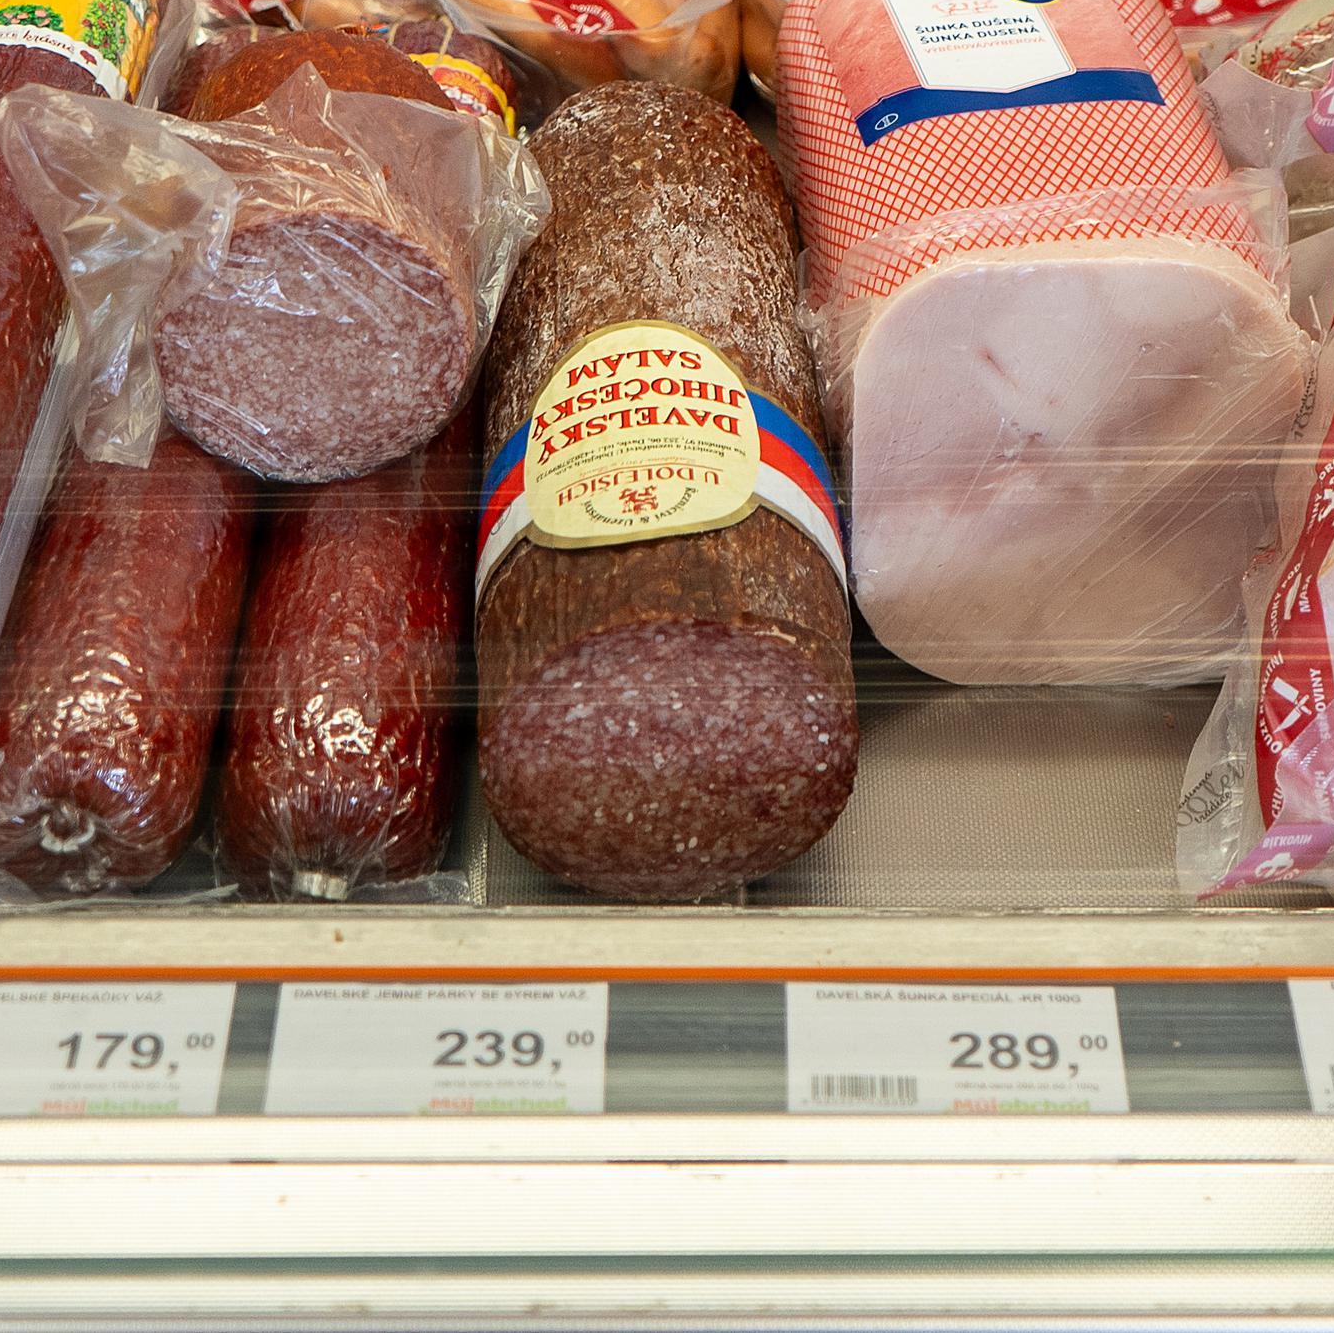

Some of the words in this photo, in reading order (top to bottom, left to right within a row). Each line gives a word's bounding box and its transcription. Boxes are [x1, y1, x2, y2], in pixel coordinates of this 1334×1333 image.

[915, 21, 970, 35] ŠUNKA
[971, 14, 1035, 29] DUŠENÁ
[919, 31, 974, 45] ŠUNKA
[566, 349, 702, 389] SALÁM
[531, 377, 746, 440] JIHOČESKÝ
[537, 406, 742, 465] DAVELSKÝ
[557, 467, 695, 507] DOLEJŠÍCH
[704, 470, 720, 486] U
[639, 515, 651, 524] &
[654, 486, 700, 523] Řeznictví
